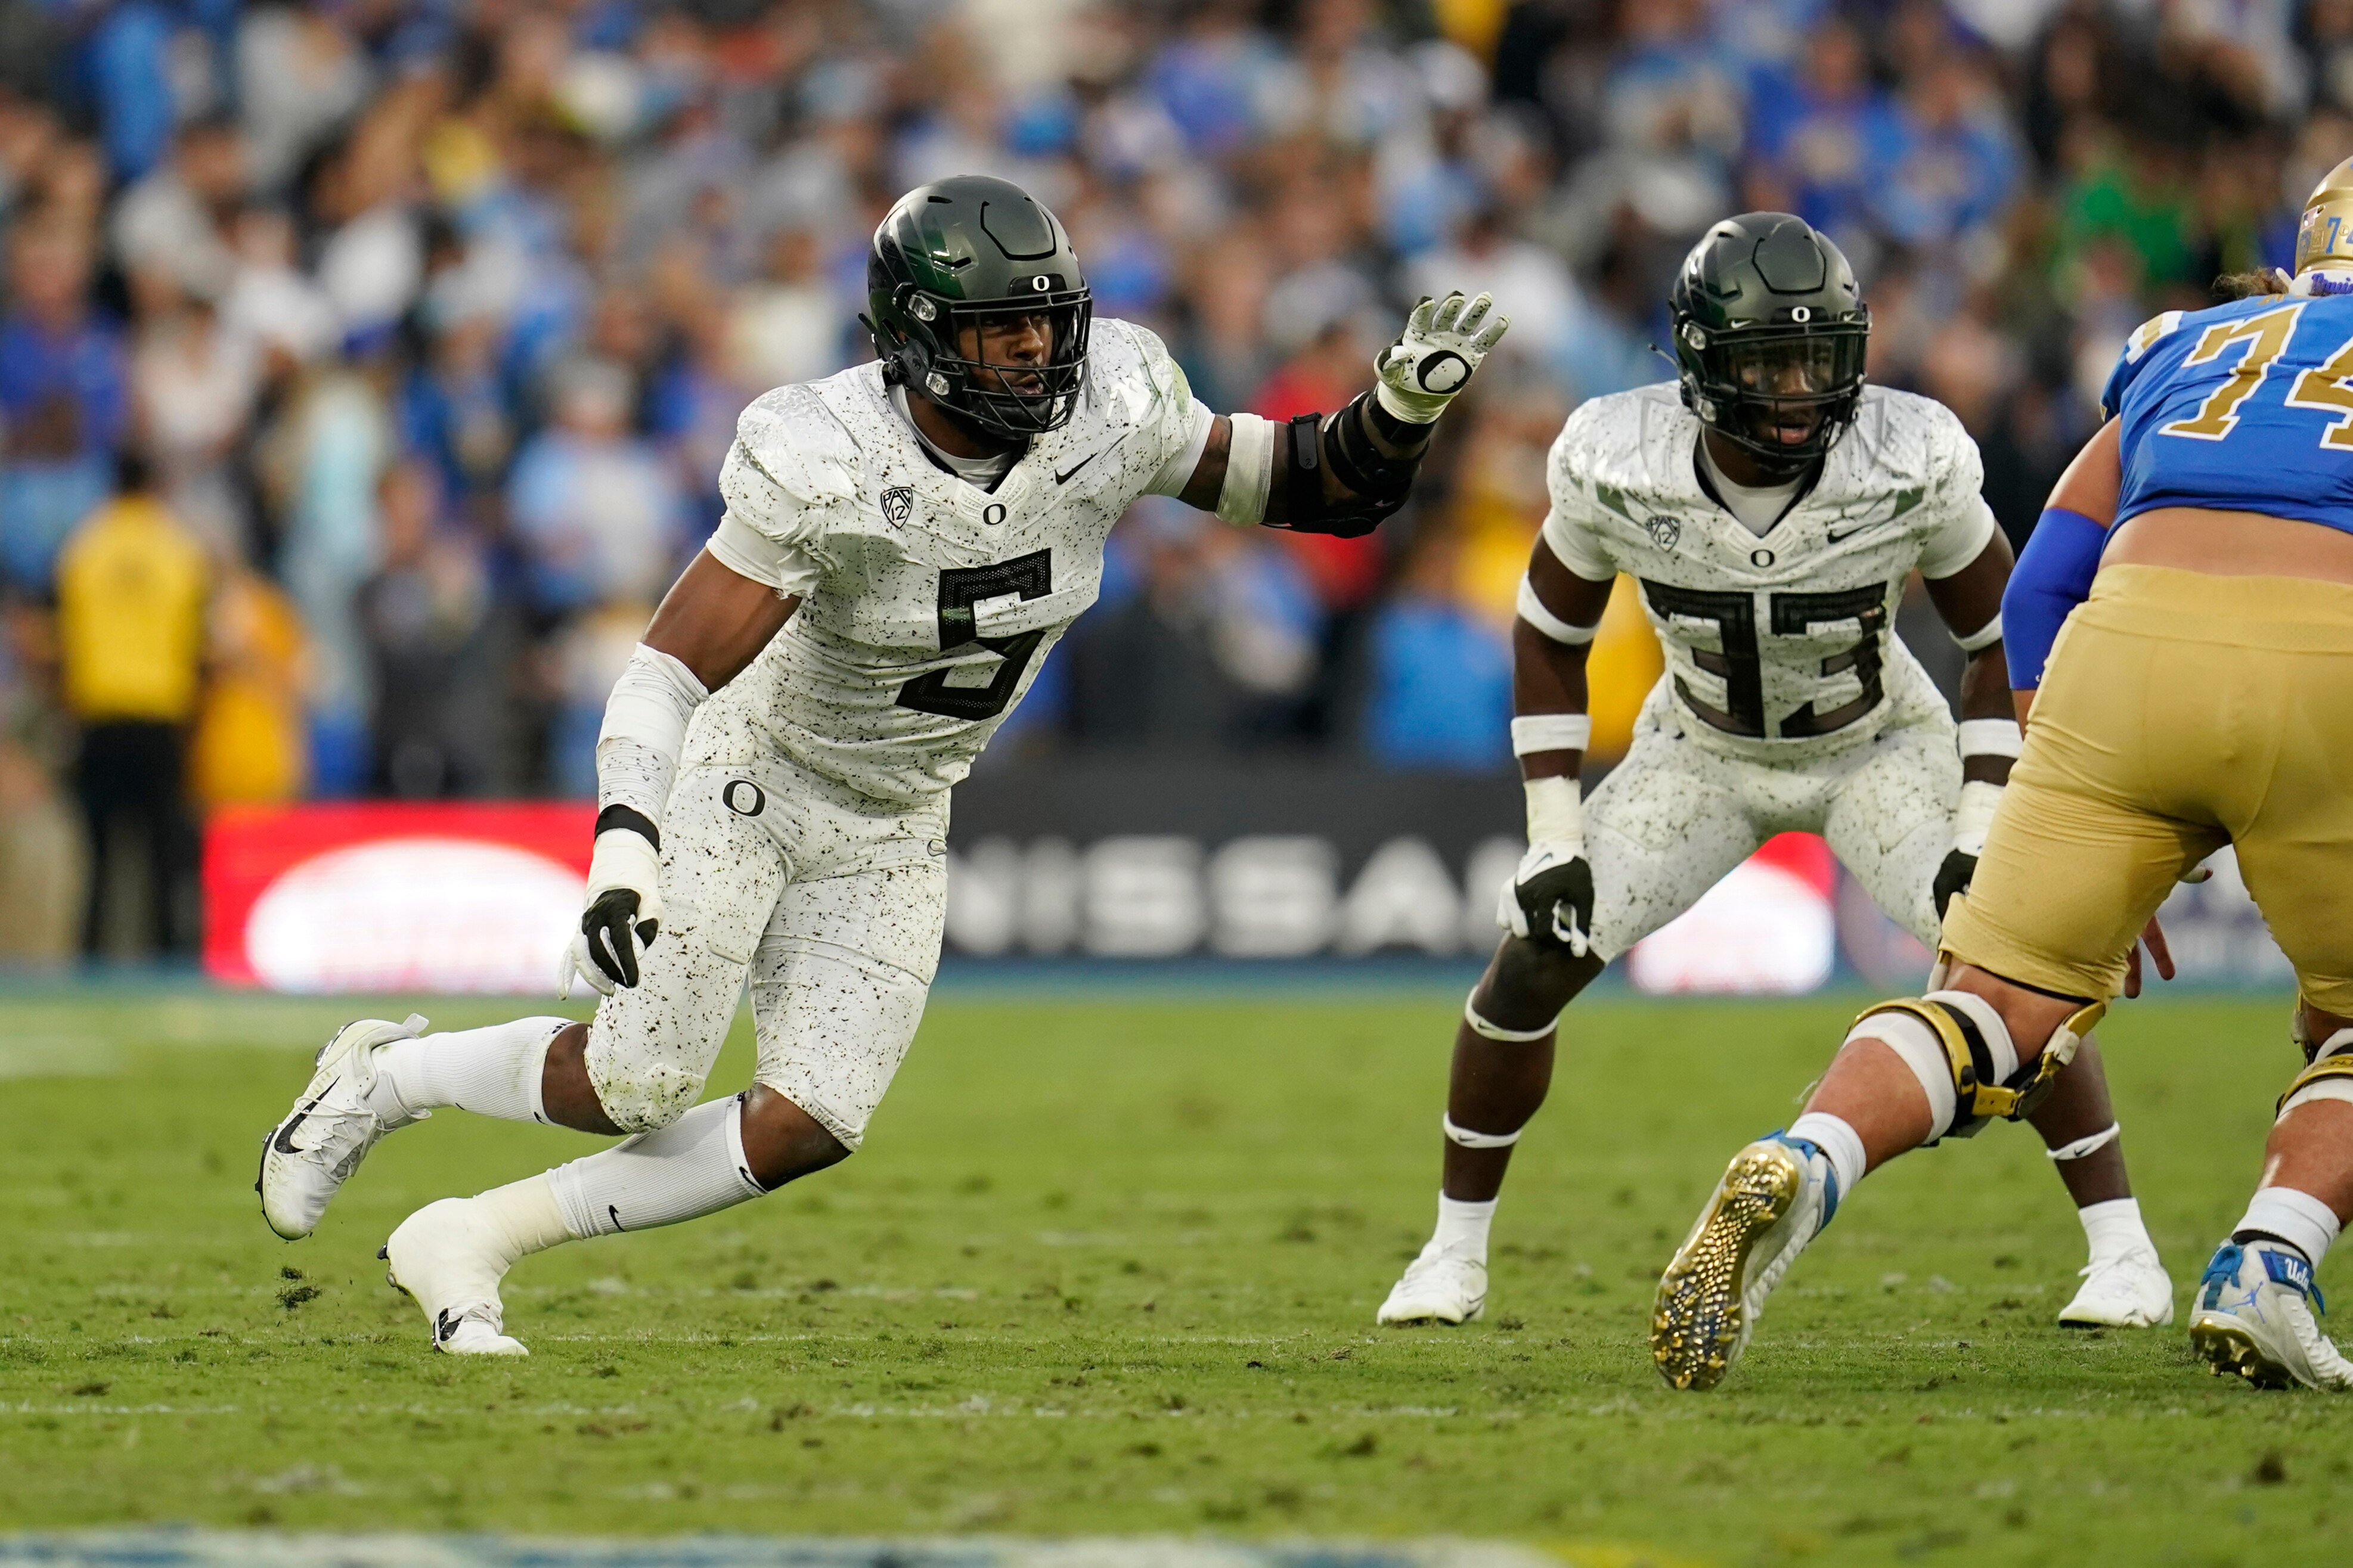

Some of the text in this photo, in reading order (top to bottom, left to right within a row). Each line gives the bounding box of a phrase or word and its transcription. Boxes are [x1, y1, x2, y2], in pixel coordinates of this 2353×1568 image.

[1033, 275, 1050, 291] O
[2311, 273, 2353, 296] Brui
[1791, 306, 1811, 323] O
[1417, 350, 1472, 395] O
[883, 489, 911, 514] PAC
[891, 506, 906, 521] 12
[983, 504, 1006, 525] O
[1750, 549, 1775, 567] O
[894, 547, 1053, 721] 5
[1639, 577, 1888, 738] 33
[722, 780, 765, 818] O
